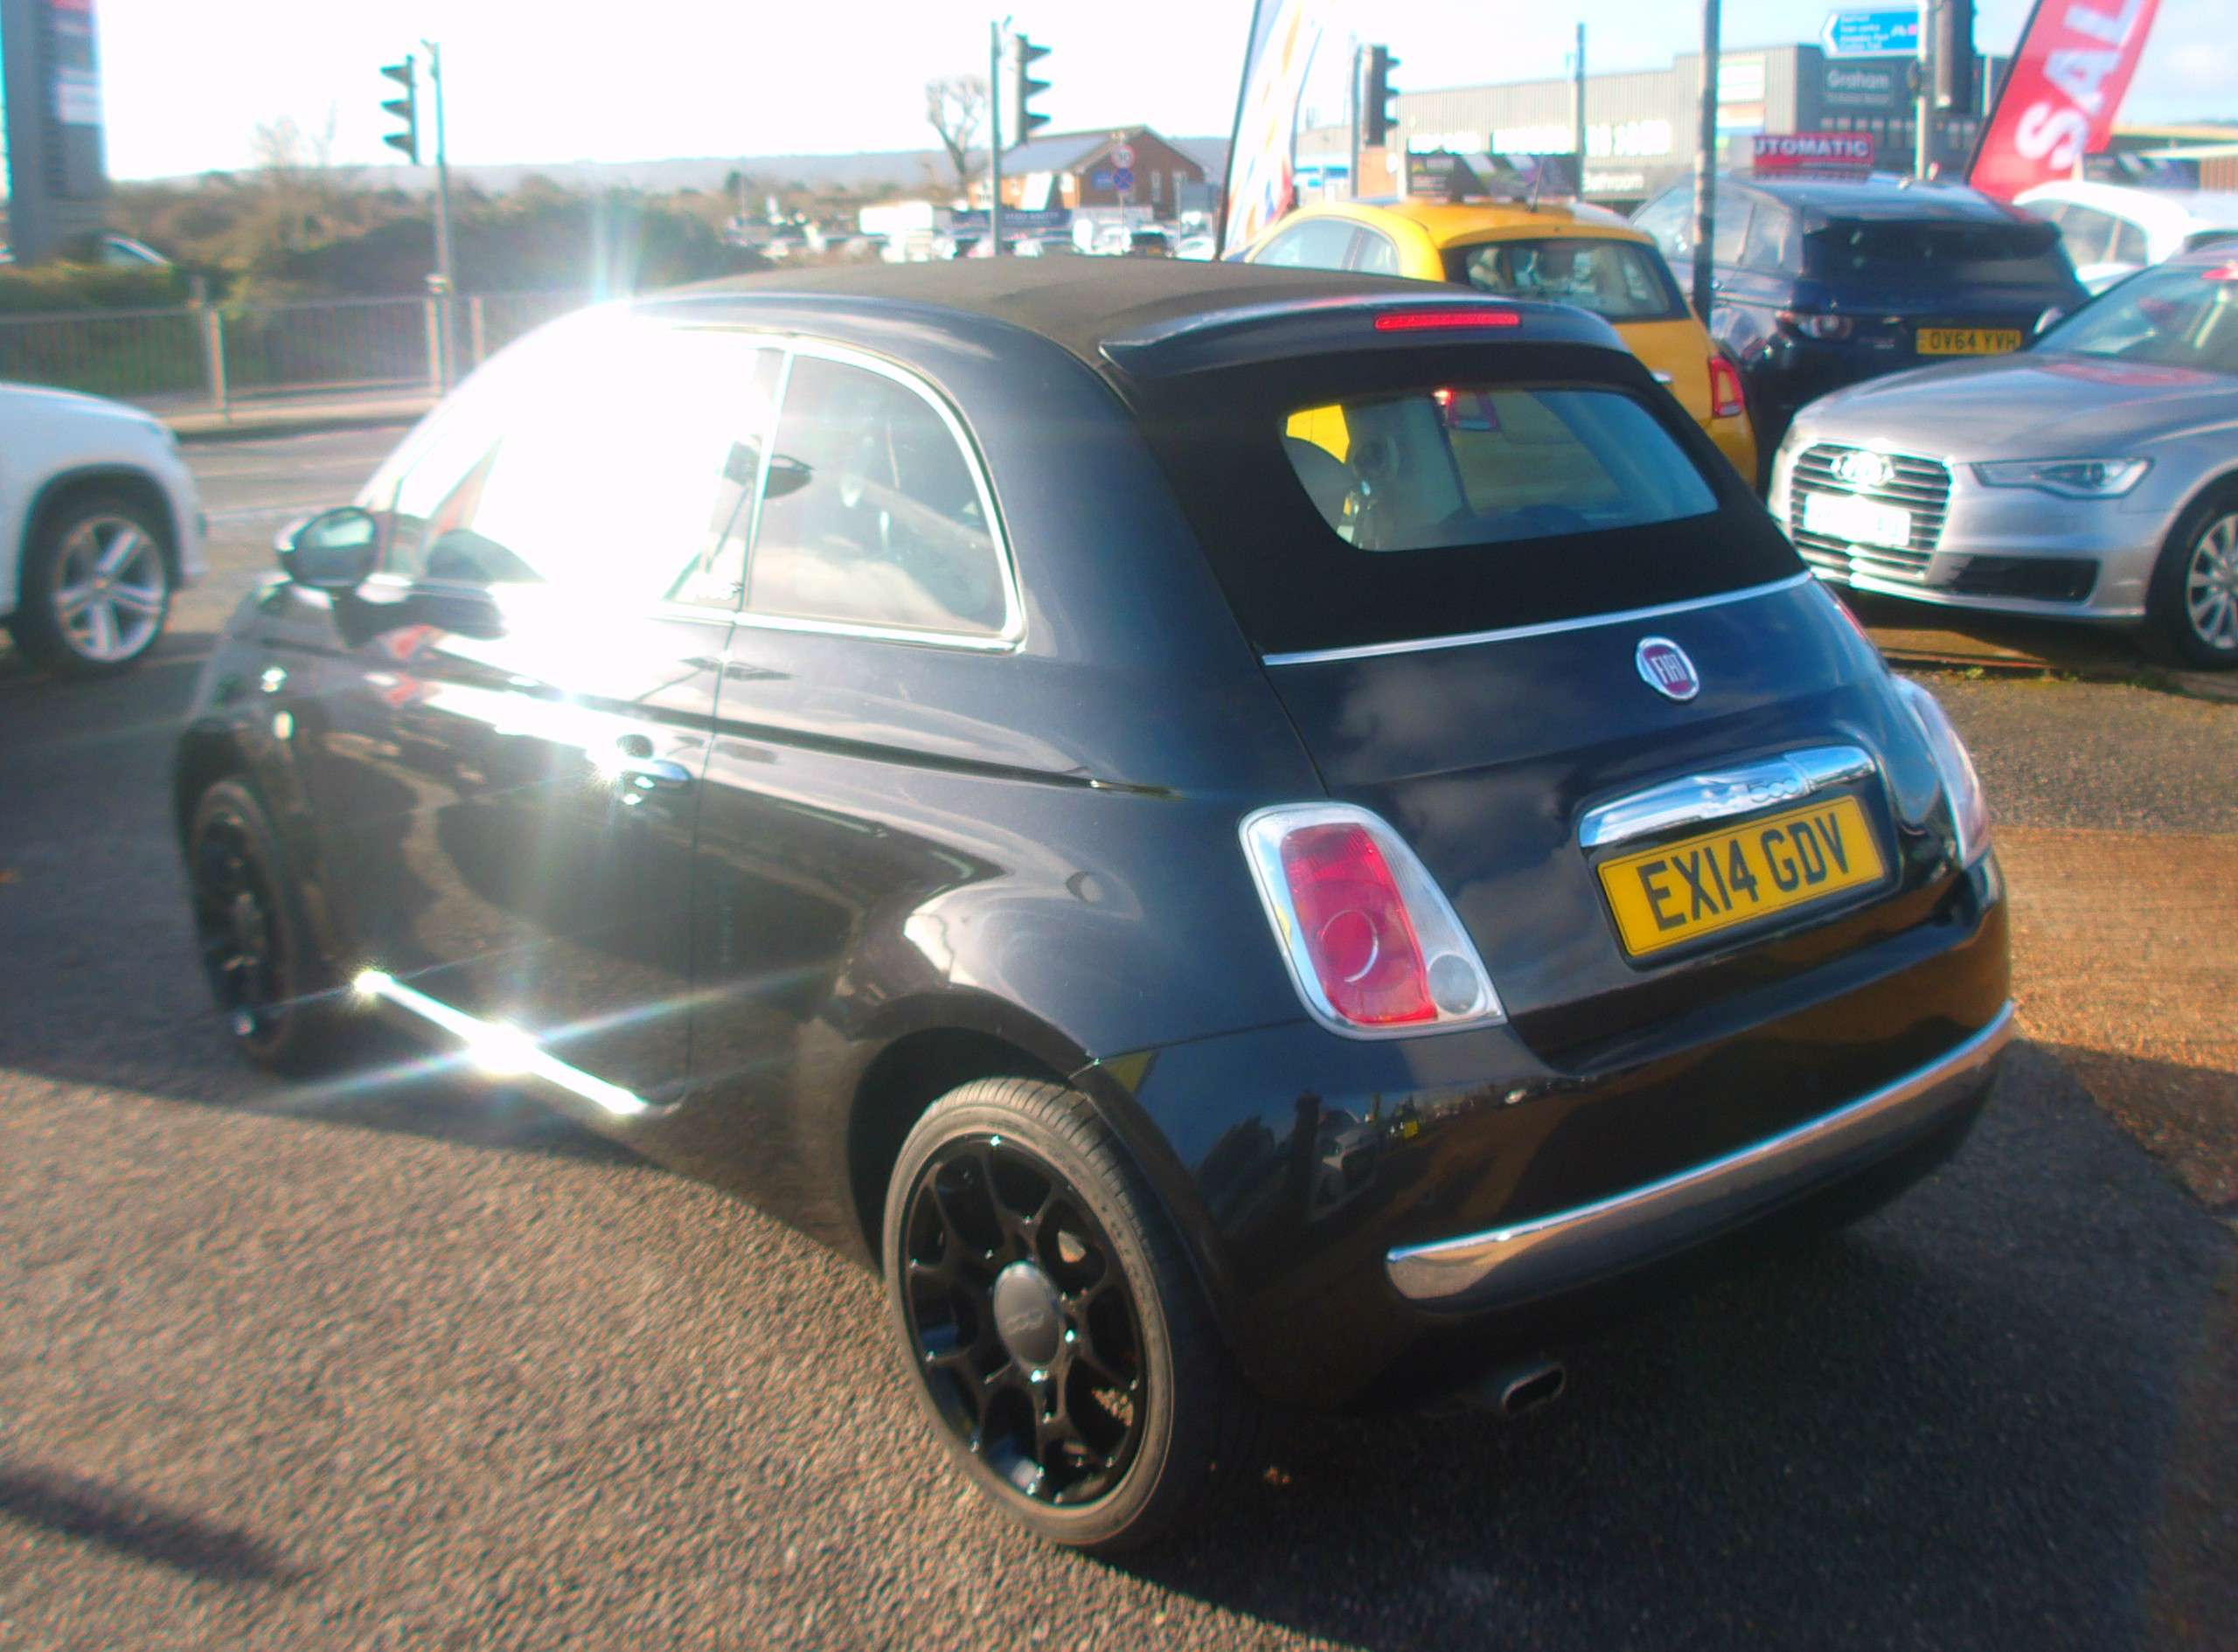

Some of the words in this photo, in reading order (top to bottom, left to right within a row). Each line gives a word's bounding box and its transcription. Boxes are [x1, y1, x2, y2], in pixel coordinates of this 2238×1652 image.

[1828, 69, 1889, 87] Graham
[1636, 838, 1759, 932] EX14
[1760, 813, 1849, 893] GDV
